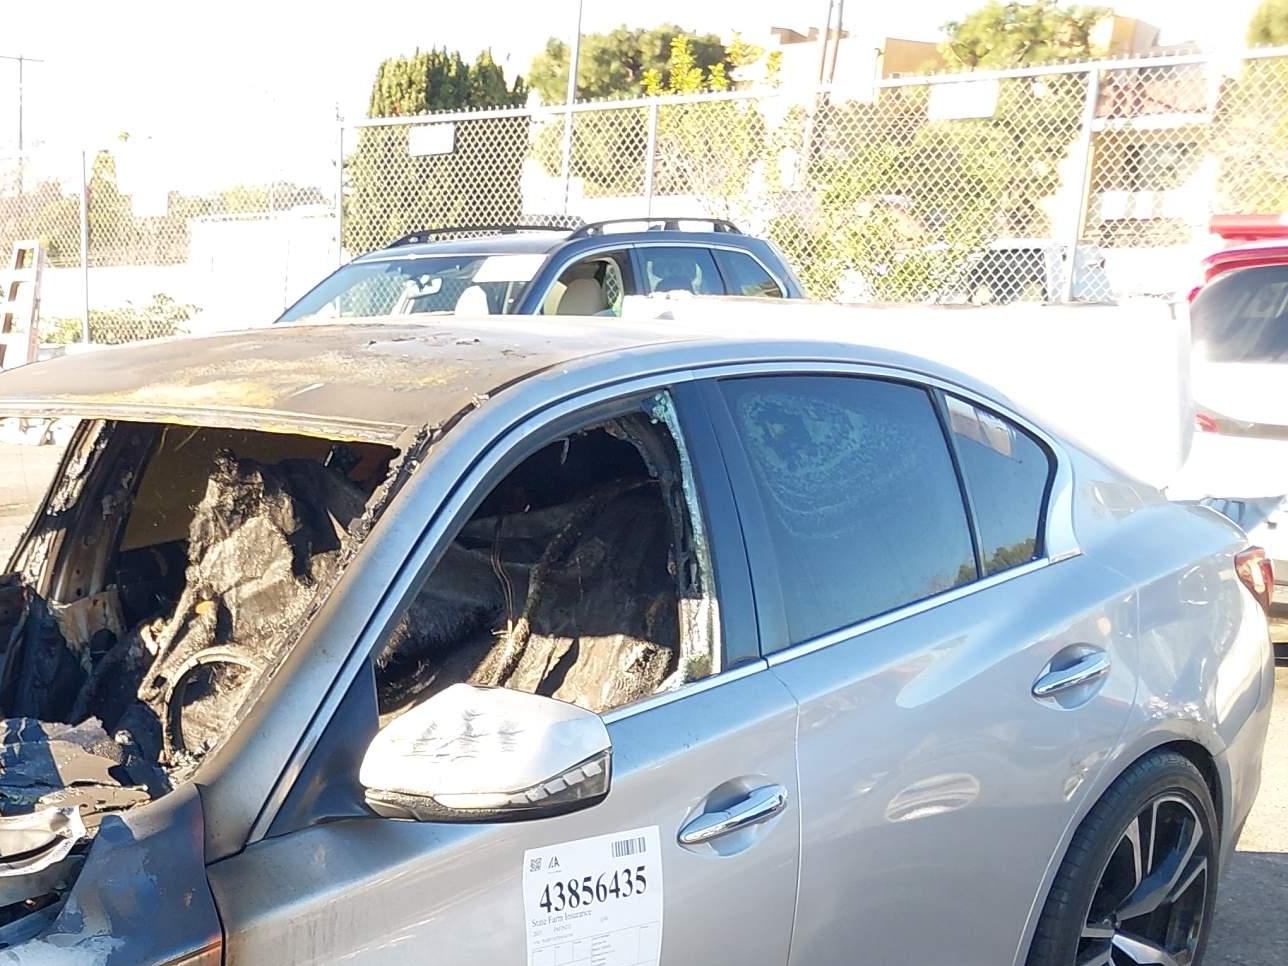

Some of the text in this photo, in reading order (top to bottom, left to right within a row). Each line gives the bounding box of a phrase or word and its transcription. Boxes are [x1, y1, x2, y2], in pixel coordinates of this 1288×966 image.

[539, 864, 647, 914] 43856435
[531, 917, 547, 928] State
[548, 914, 564, 925] Farm
[564, 910, 593, 922] Insurance
